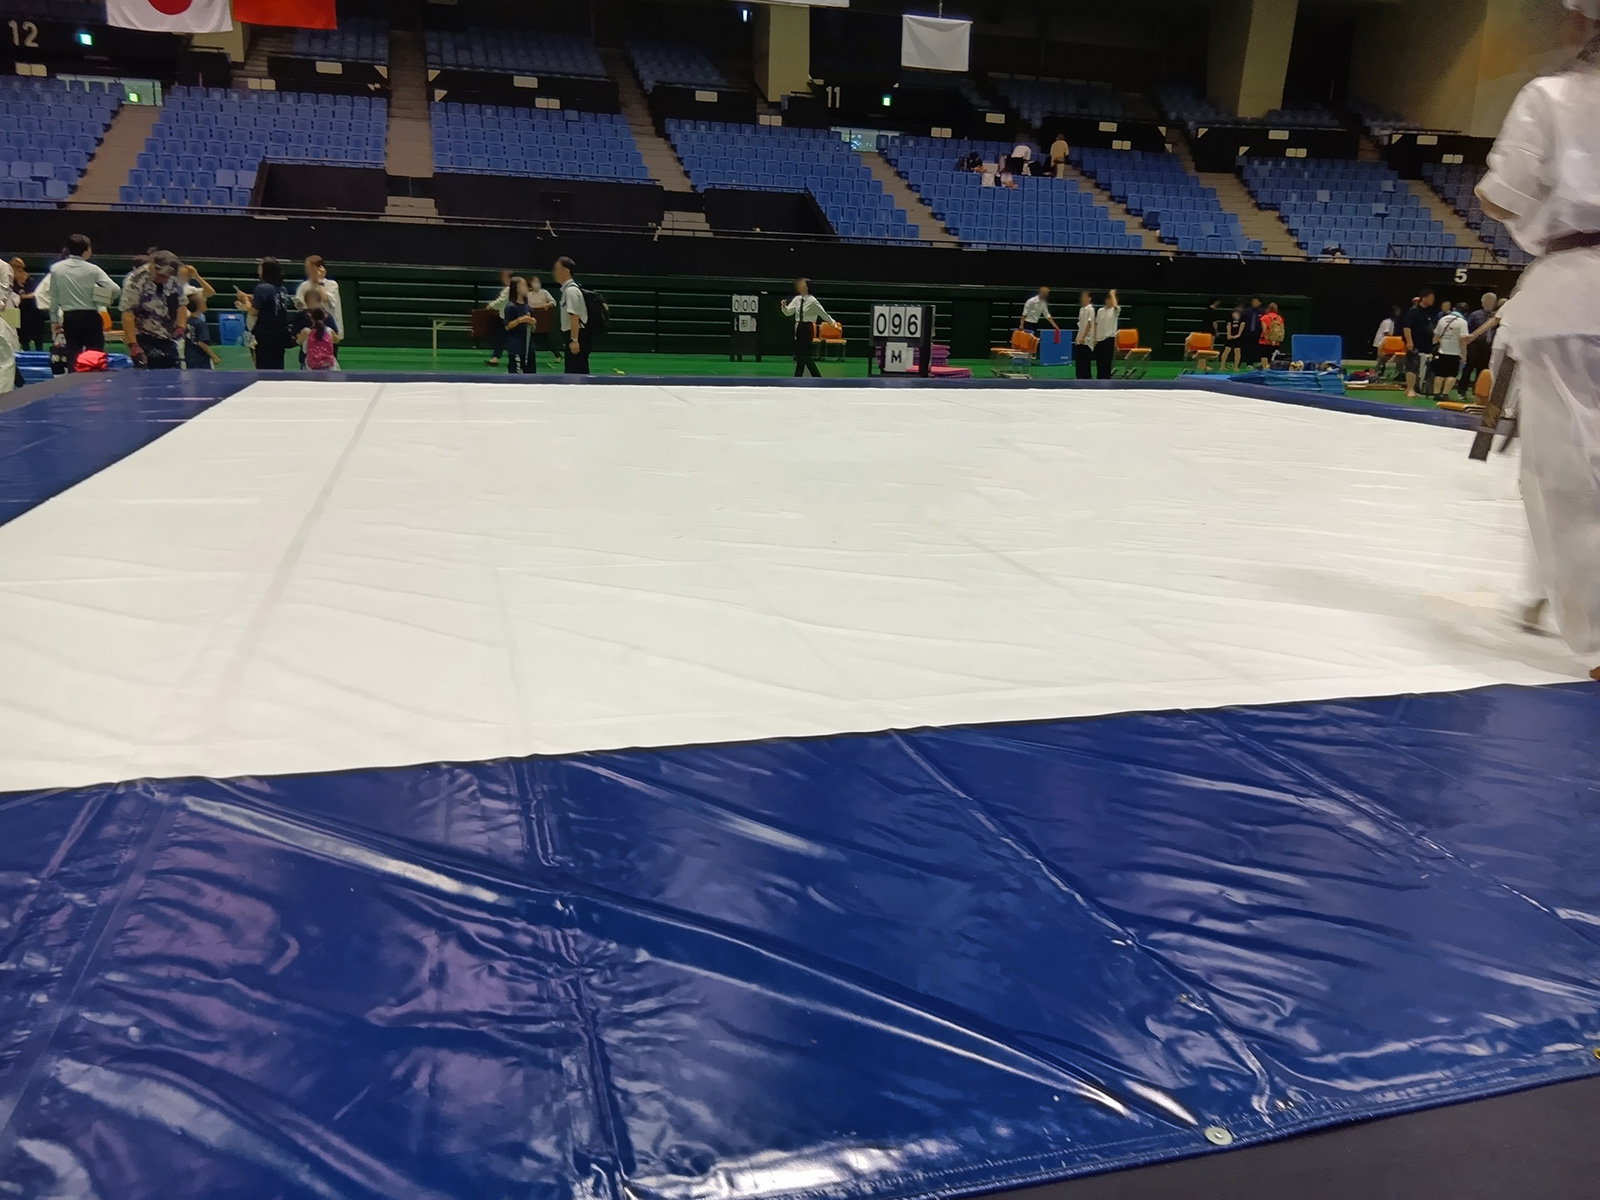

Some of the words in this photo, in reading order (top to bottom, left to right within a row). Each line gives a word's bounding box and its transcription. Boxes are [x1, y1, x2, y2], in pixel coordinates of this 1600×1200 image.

[8, 20, 39, 48] 12
[826, 86, 841, 108] 11
[1454, 269, 1468, 283] 5
[734, 299, 756, 312] 000
[875, 312, 919, 335] 096
[891, 350, 903, 364] M
